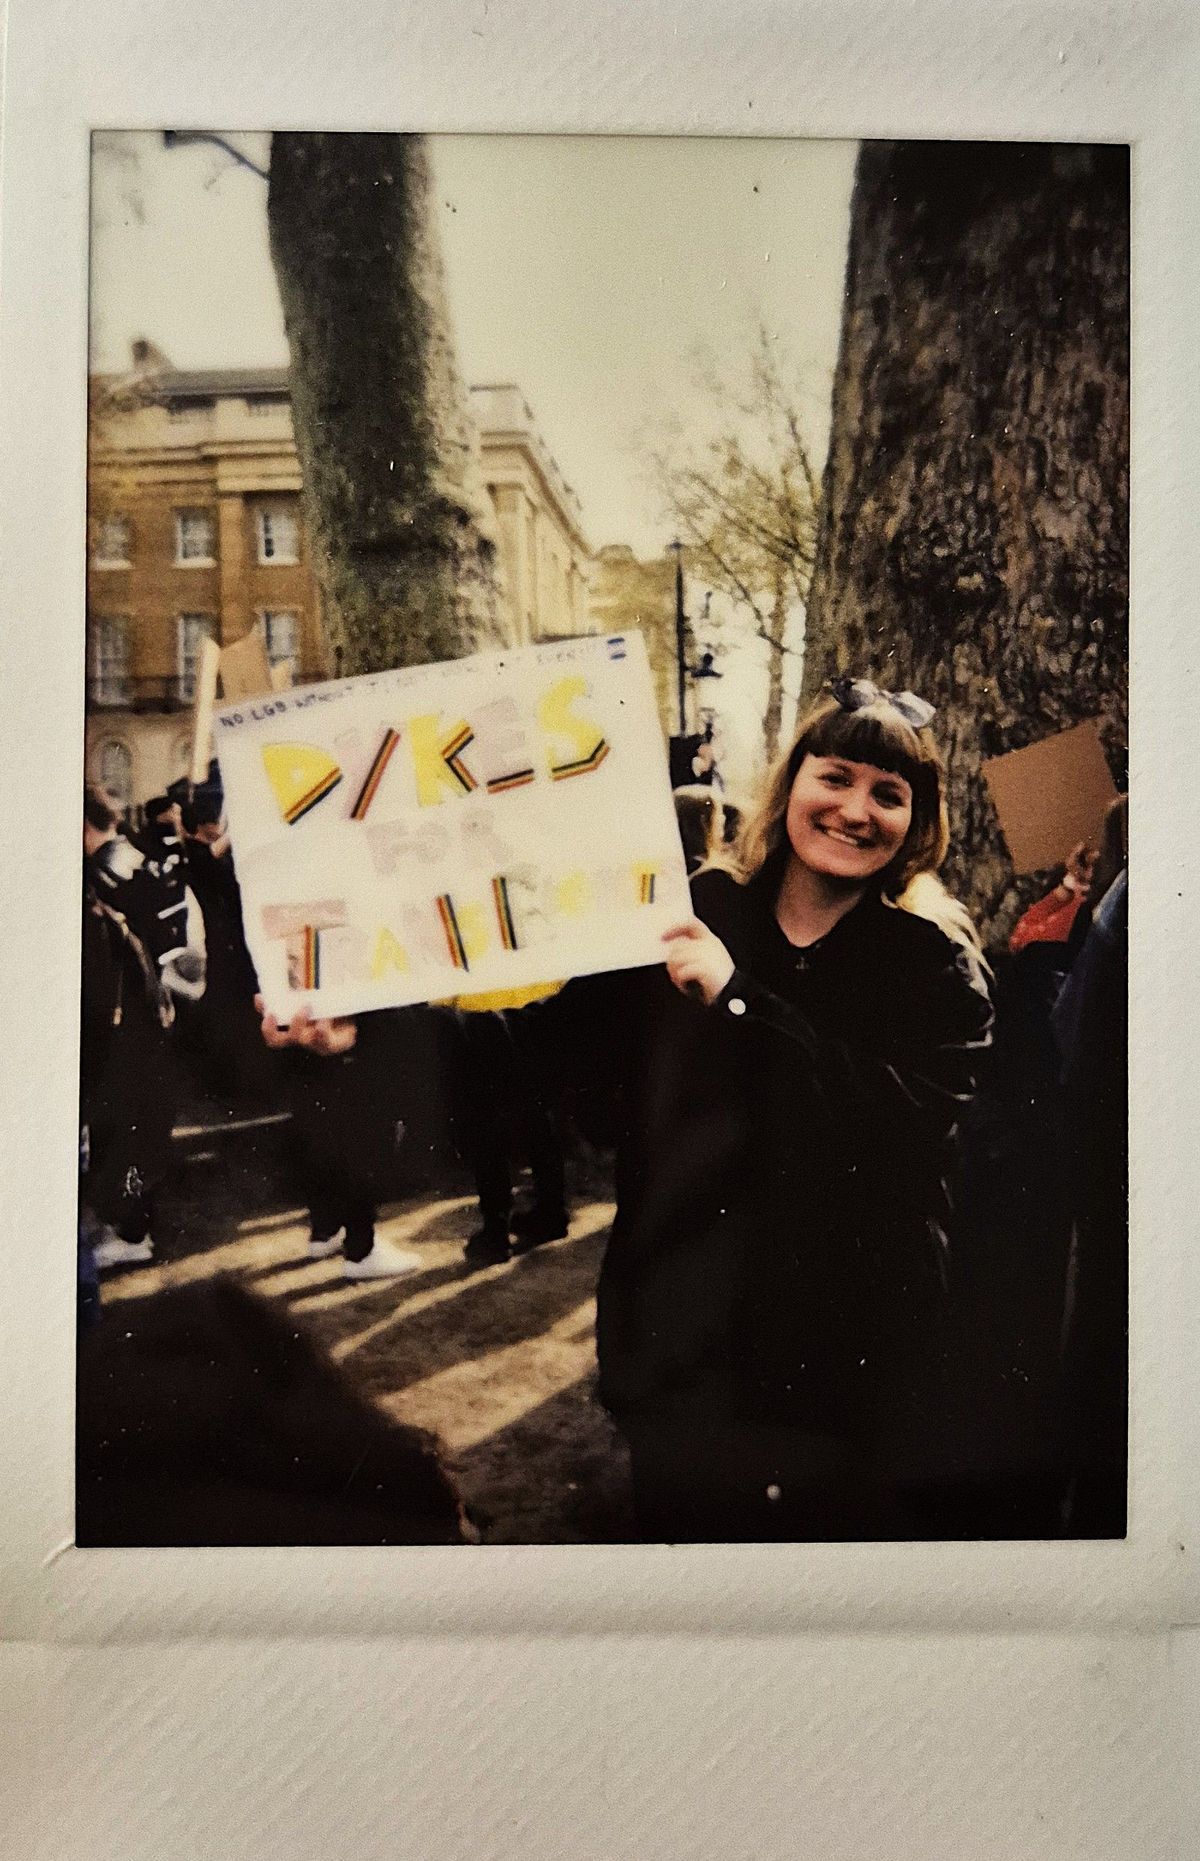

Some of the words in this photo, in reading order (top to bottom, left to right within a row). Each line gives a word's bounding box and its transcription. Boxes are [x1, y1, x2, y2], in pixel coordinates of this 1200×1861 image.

[219, 709, 244, 729] NO
[252, 699, 287, 722] LGB
[261, 675, 611, 825] DYKES
[365, 807, 513, 875] FOR
